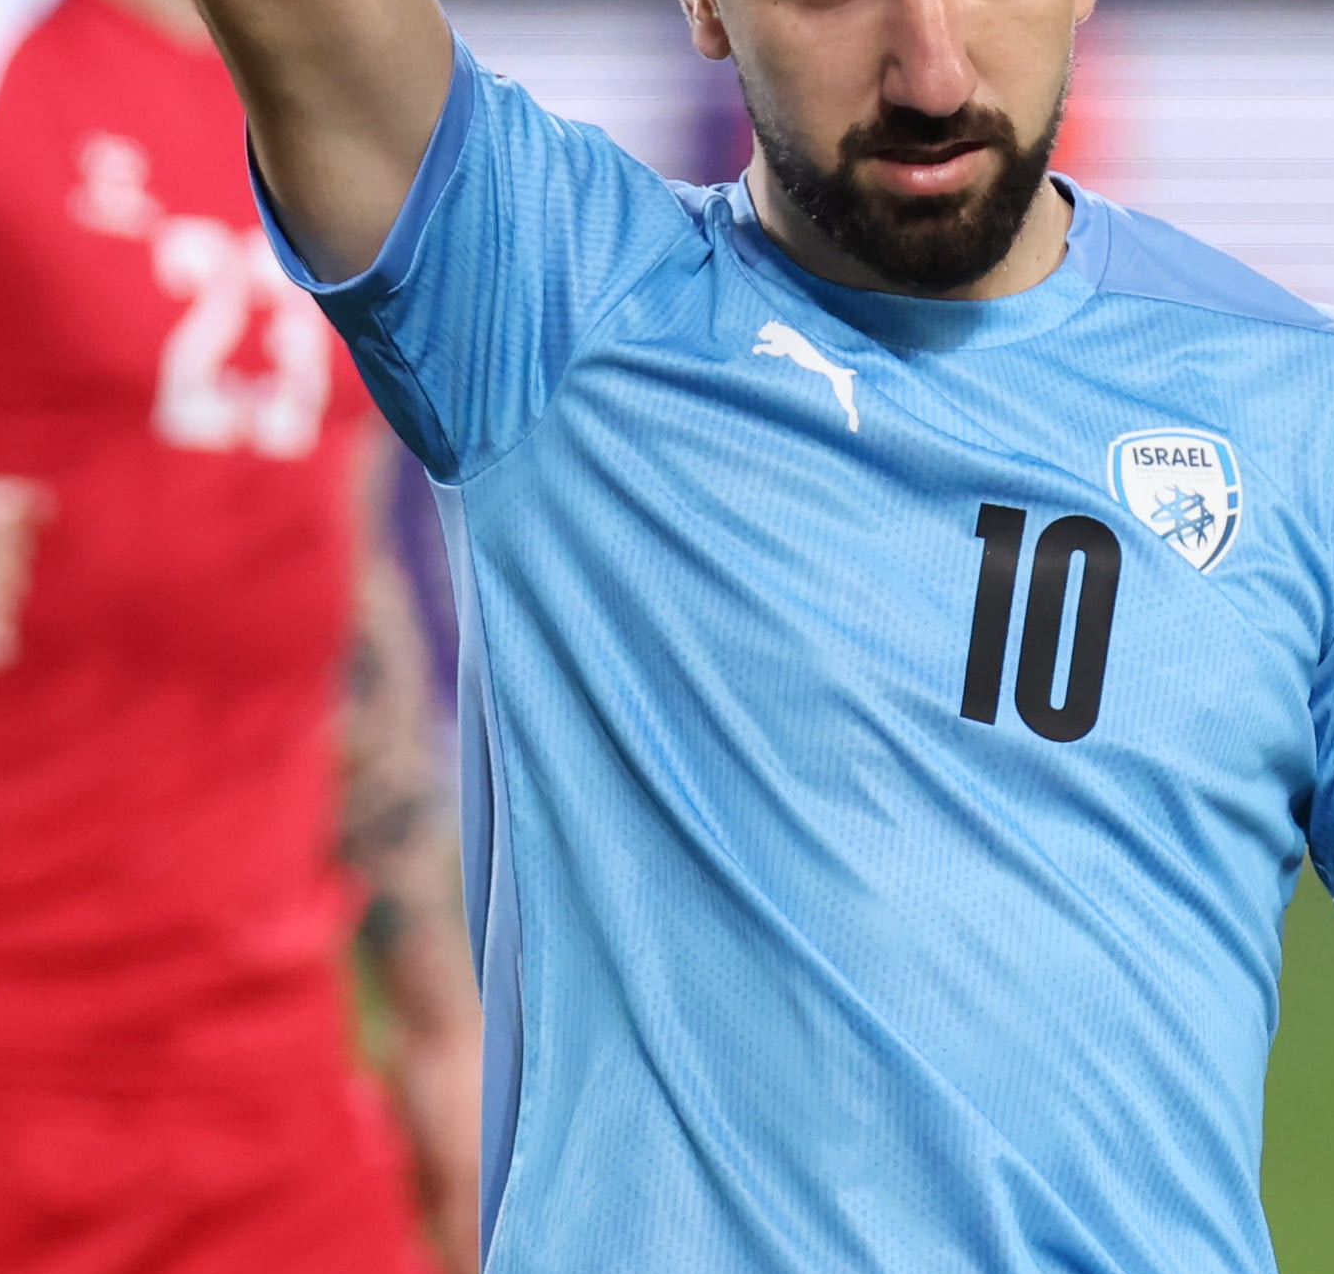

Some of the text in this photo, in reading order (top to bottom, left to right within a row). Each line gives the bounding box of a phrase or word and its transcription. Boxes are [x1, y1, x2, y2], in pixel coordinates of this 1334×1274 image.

[152, 214, 330, 458] 23
[1132, 446, 1213, 468] ISRAEL
[960, 503, 1122, 743] 10
